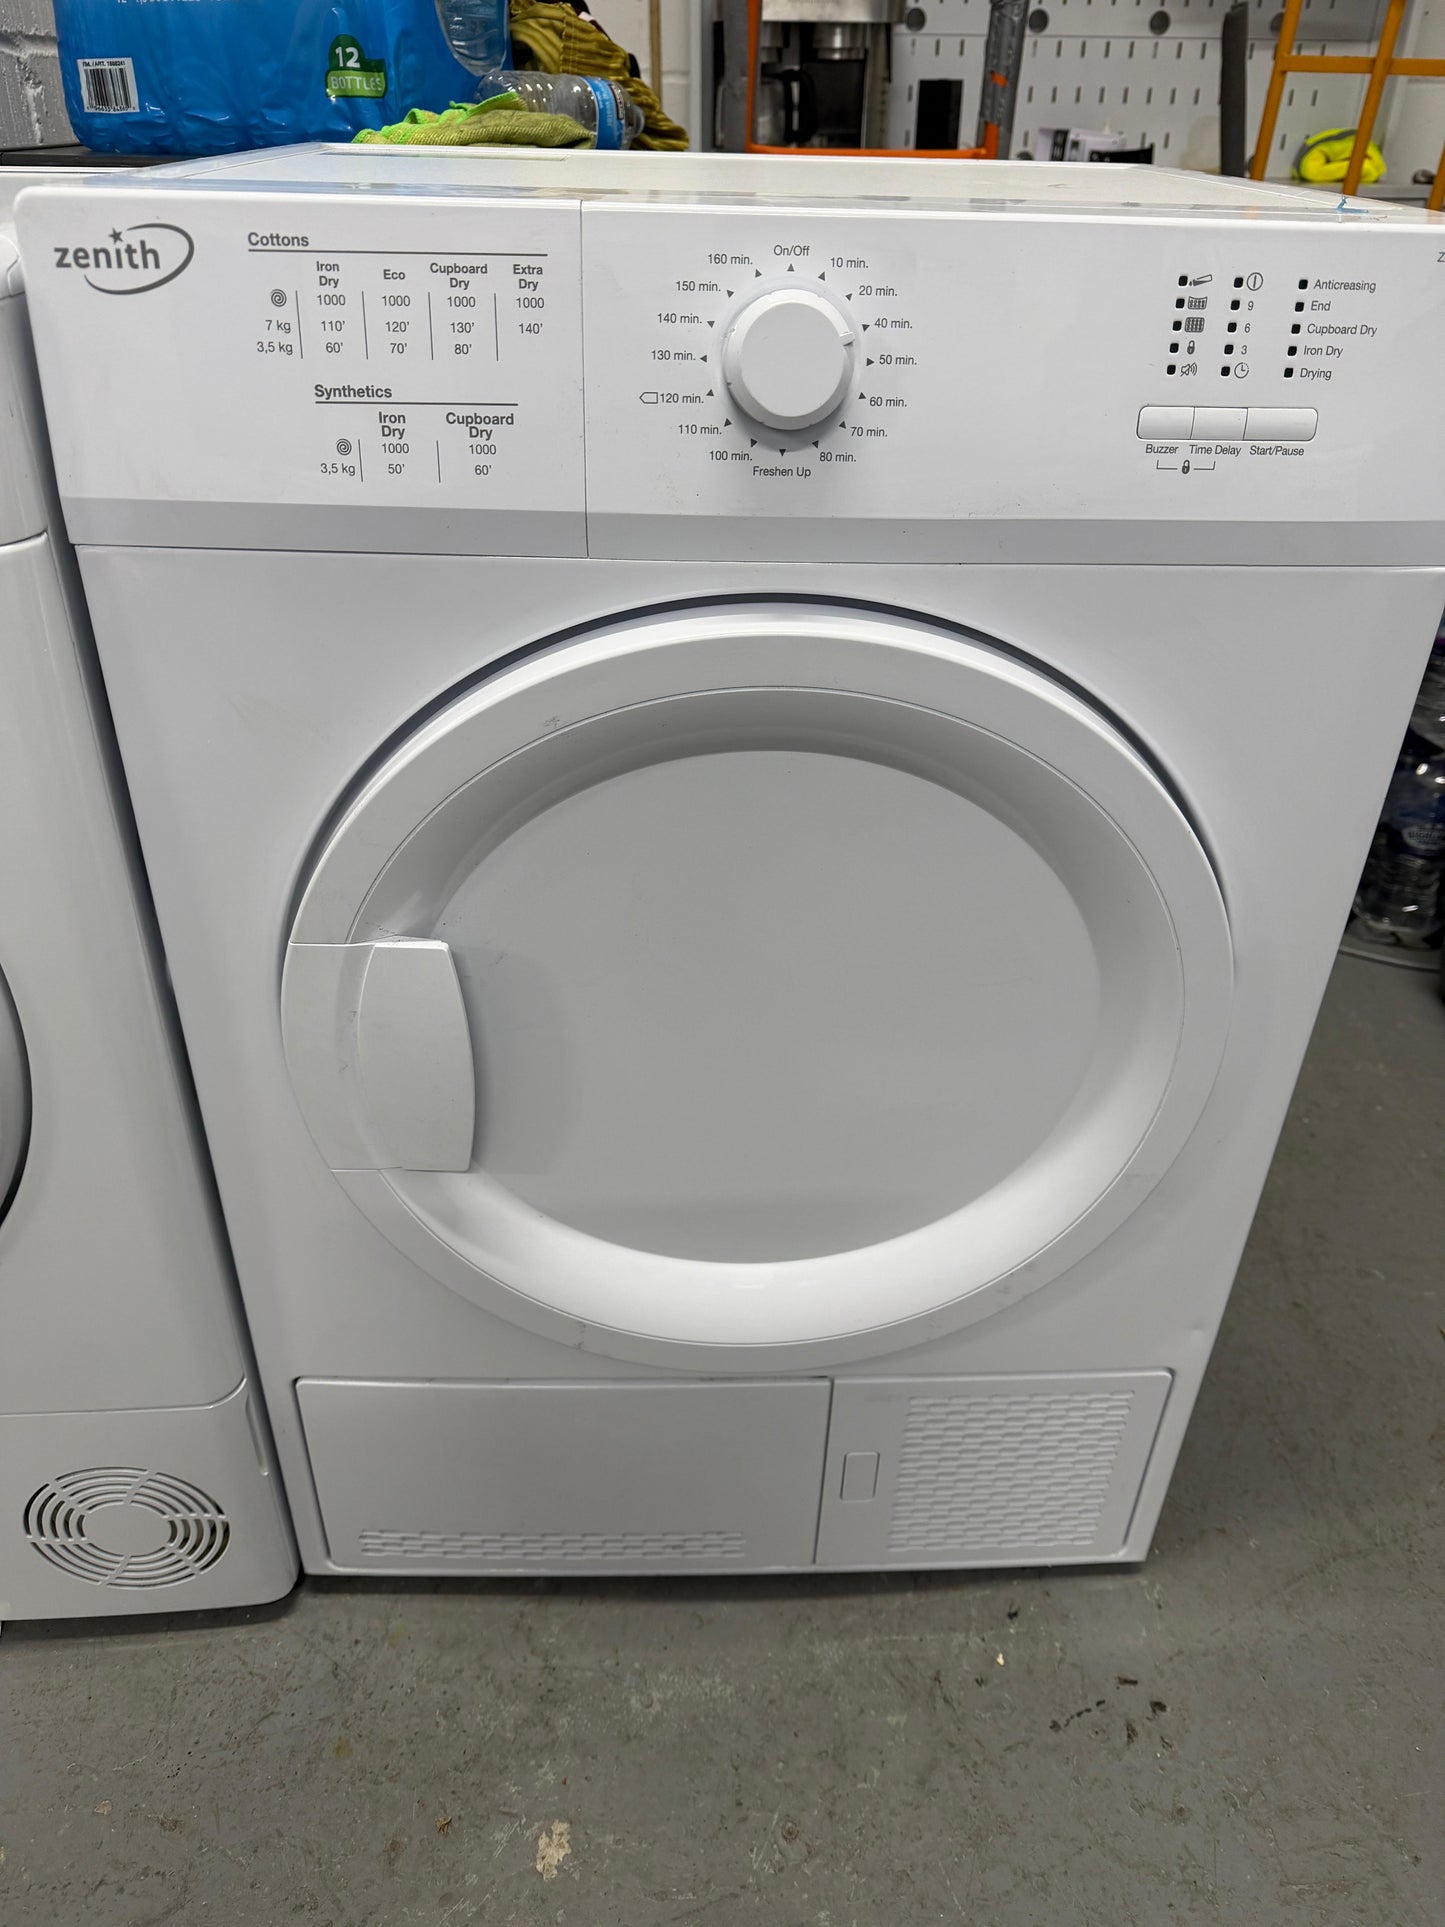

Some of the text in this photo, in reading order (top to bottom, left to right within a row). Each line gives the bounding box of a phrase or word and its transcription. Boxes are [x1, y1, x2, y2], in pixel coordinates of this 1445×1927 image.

[335, 46, 360, 68] 12
[331, 75, 382, 91] BOTTLES
[248, 232, 309, 247] Cottons
[54, 232, 160, 269] zenith
[774, 245, 810, 256] On/Off
[708, 254, 752, 264] 160 min.
[831, 257, 868, 268] 10 min.
[317, 261, 339, 271] Iron
[430, 263, 487, 275] Cupboard
[513, 264, 543, 275] Extra
[384, 269, 405, 280] Eco
[319, 276, 339, 288] Dry
[450, 278, 469, 290] Dry
[519, 279, 538, 291] Dry
[676, 281, 720, 291] 150 min.
[1314, 279, 1376, 293] Anticreasing
[859, 285, 897, 296] 20 min.
[317, 294, 345, 305] 1000
[382, 295, 410, 306] 1000
[448, 296, 475, 307] 1000
[517, 297, 544, 308] 1000
[1248, 301, 1254, 311] 9
[1311, 301, 1331, 311] End
[658, 313, 702, 323] 140 min.
[874, 318, 912, 328] 40 min.
[266, 320, 291, 334] 7 kg
[1245, 323, 1250, 333] 6
[1307, 323, 1377, 337] Cupboard Dry
[257, 341, 293, 355] 3,5 kg
[1241, 345, 1247, 355] 3
[1304, 345, 1343, 358] Iron Dry
[652, 350, 695, 360] 130 min.
[880, 355, 917, 365] 50 min.
[1300, 368, 1332, 381] Drying
[315, 384, 392, 400] Synthetics
[660, 393, 704, 403] 120 min.
[870, 397, 907, 407] 60 min.
[379, 412, 405, 423] Iron
[446, 412, 514, 427] Cupboard
[382, 425, 405, 440] Dry
[469, 426, 493, 441] Dry
[678, 424, 722, 434] 110 min.
[851, 427, 887, 437] 70 min.
[382, 443, 409, 453] 1000
[469, 444, 496, 455] 1000
[1146, 444, 1179, 454] Buzzer
[1189, 444, 1241, 457] Time Delay
[1250, 445, 1304, 455] Start/Pause
[710, 451, 752, 461] 100 min.
[820, 452, 856, 462] 80 min.
[321, 463, 355, 476] 3,5 kg
[753, 466, 811, 479] Freshen Up
